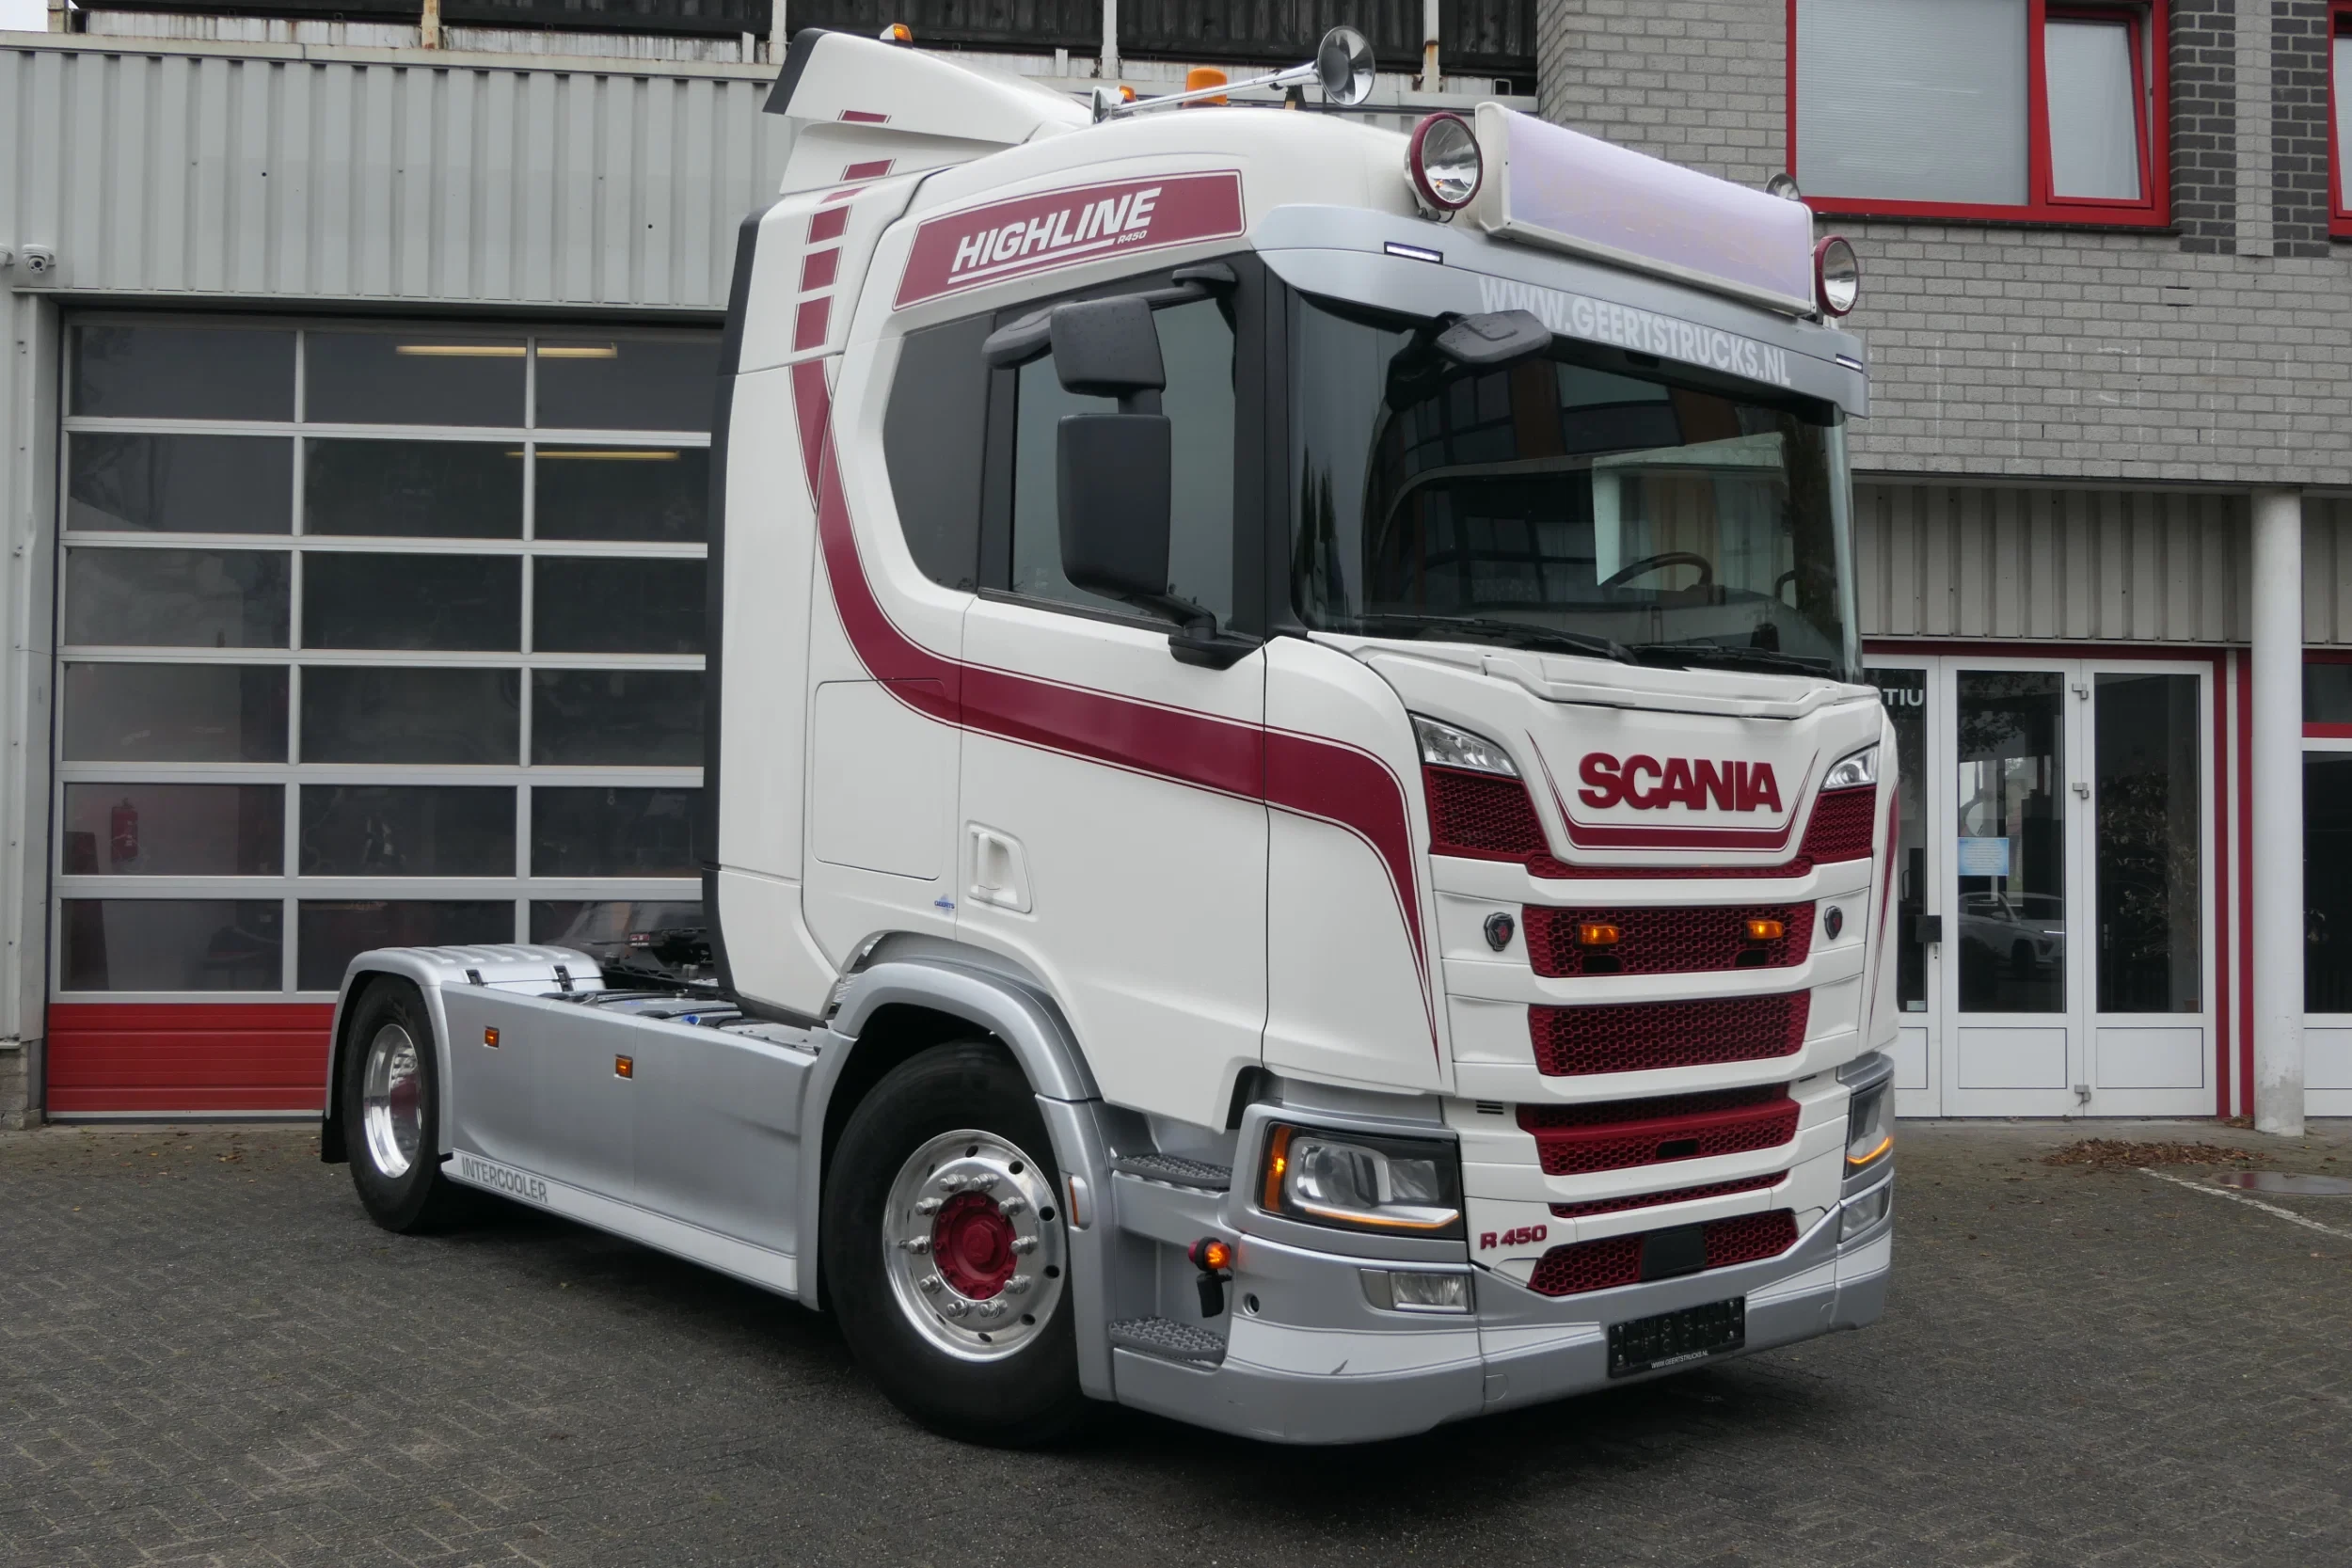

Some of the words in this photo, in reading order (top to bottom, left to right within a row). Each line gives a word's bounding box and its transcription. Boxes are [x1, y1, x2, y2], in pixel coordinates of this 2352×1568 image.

[950, 186, 1163, 274] HIGHLINE
[1117, 230, 1148, 245] R450
[1478, 276, 1791, 387] WWW.GEERTSTRUCKS.NL
[1577, 752, 1784, 814] SCANIA
[461, 1156, 548, 1204] INTERCOOLER
[1480, 1231, 1498, 1250] R
[1500, 1225, 1548, 1246] 450
